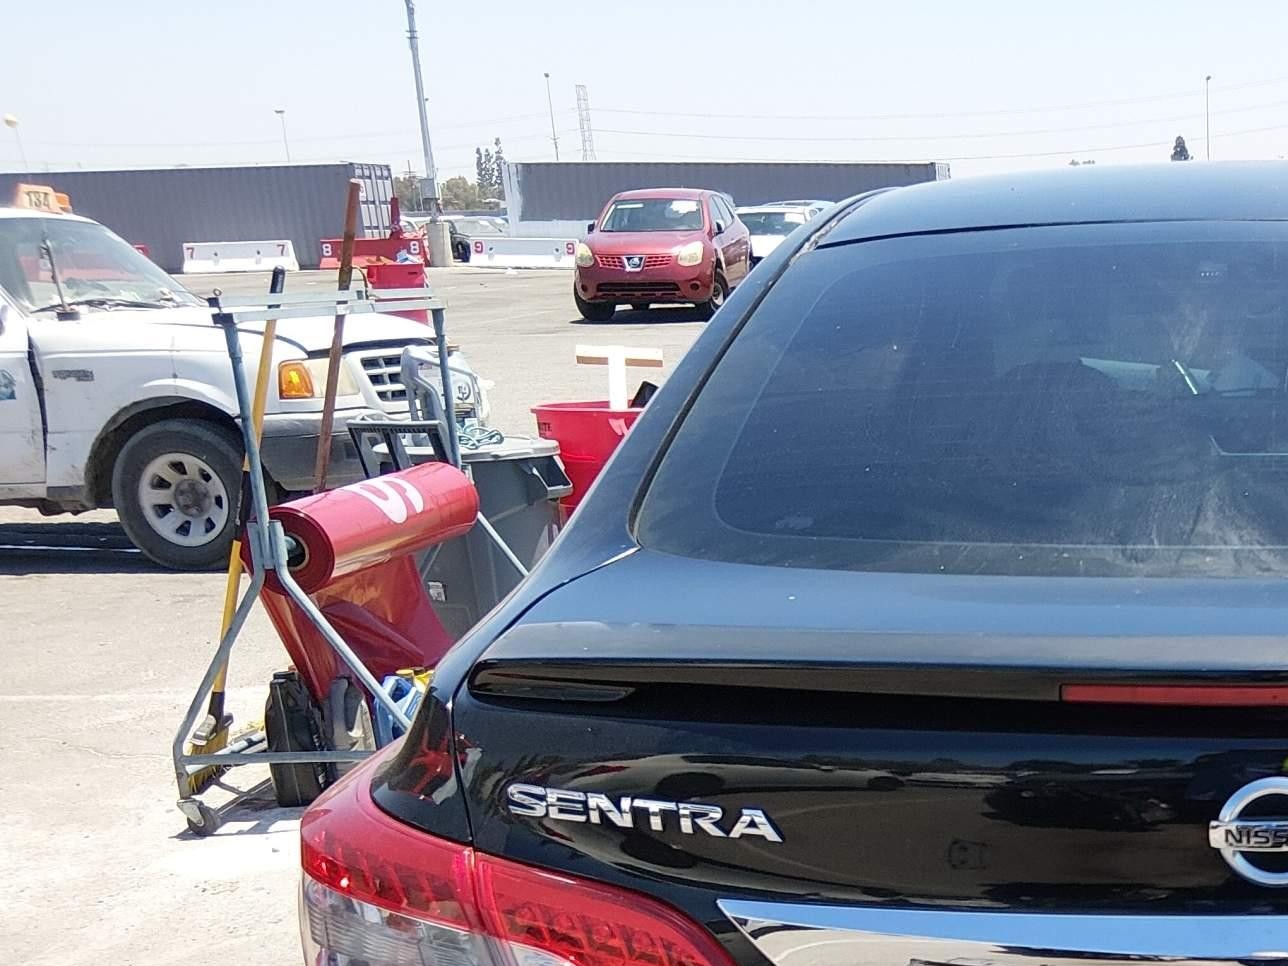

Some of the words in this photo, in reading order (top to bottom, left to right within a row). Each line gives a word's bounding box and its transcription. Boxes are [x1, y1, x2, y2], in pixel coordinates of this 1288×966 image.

[186, 247, 195, 260] 7
[277, 244, 285, 257] 7
[322, 243, 332, 256] 8
[410, 240, 420, 254] 8
[474, 241, 484, 254] 9
[565, 242, 575, 255] 9
[507, 783, 785, 843] SENTRA
